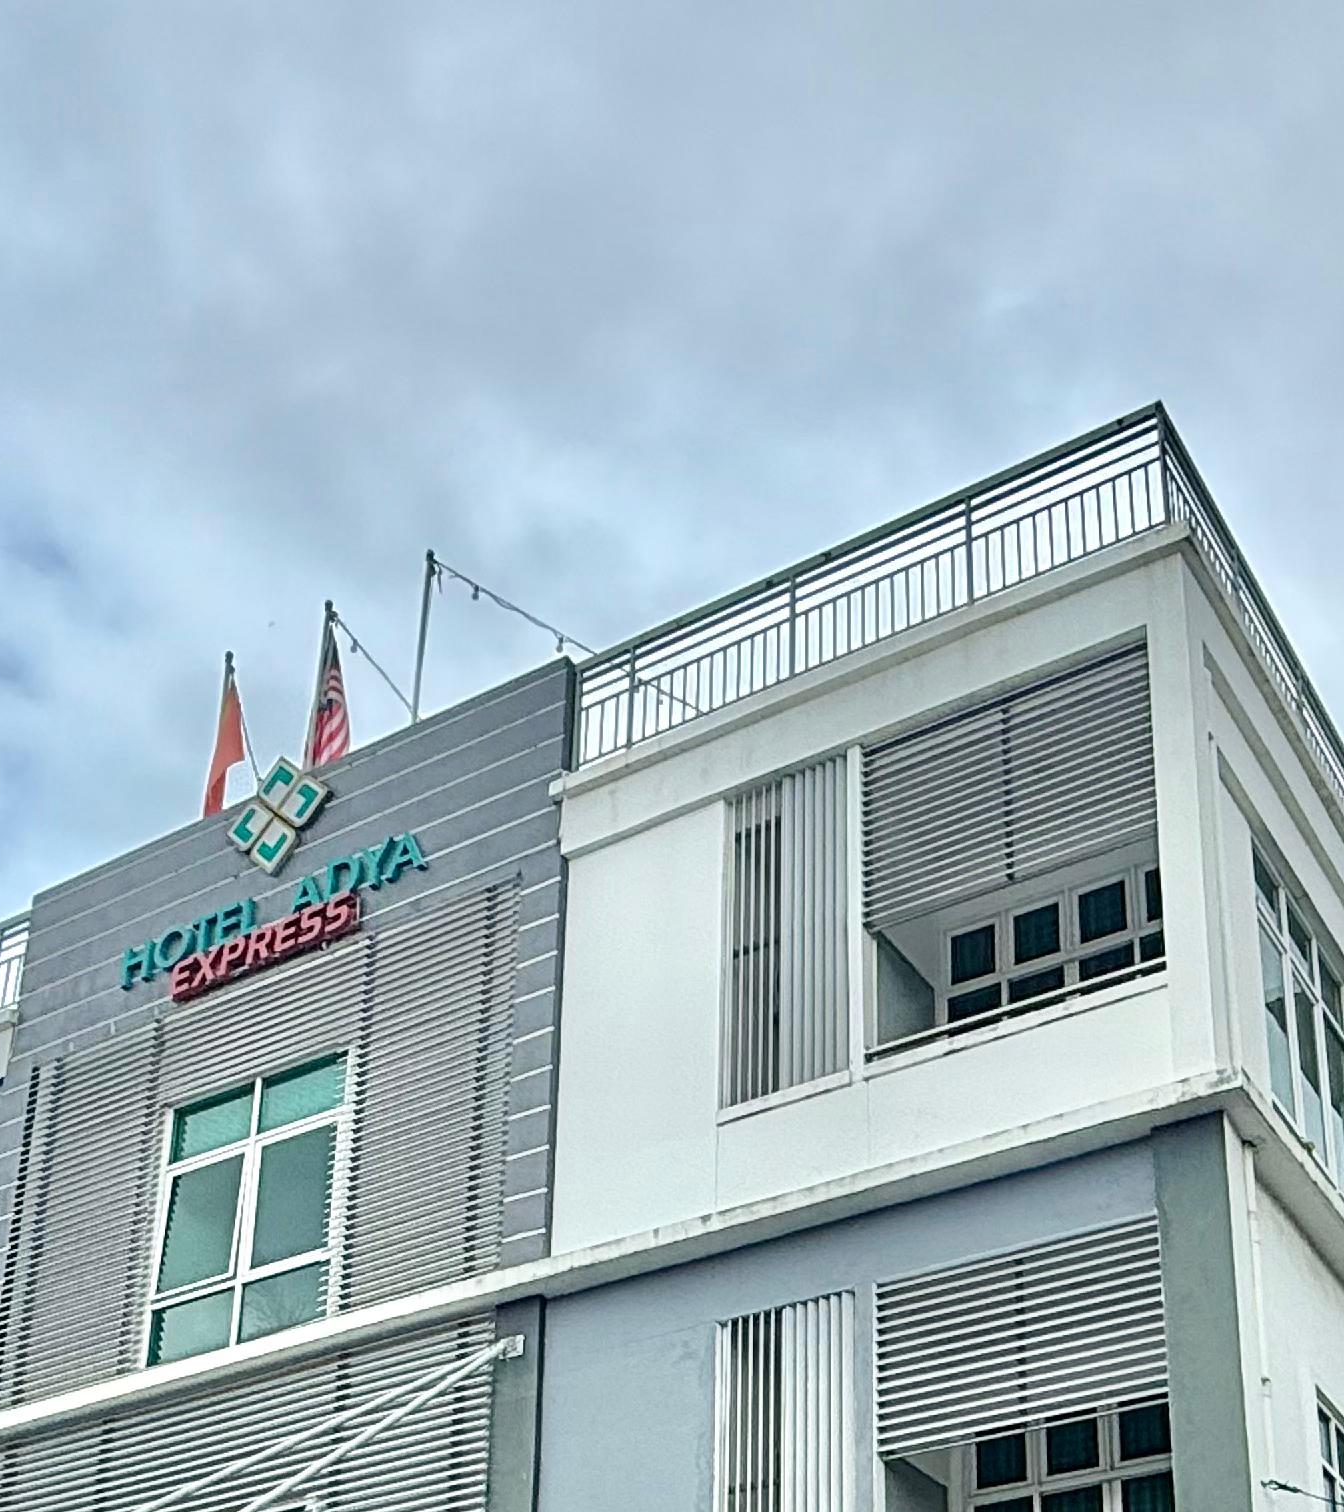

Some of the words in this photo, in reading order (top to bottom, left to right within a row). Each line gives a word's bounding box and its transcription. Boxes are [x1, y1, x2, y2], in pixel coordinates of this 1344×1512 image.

[120, 897, 257, 990] HOTEL
[291, 831, 429, 913] ADYA
[170, 892, 353, 995] EXPRESS
